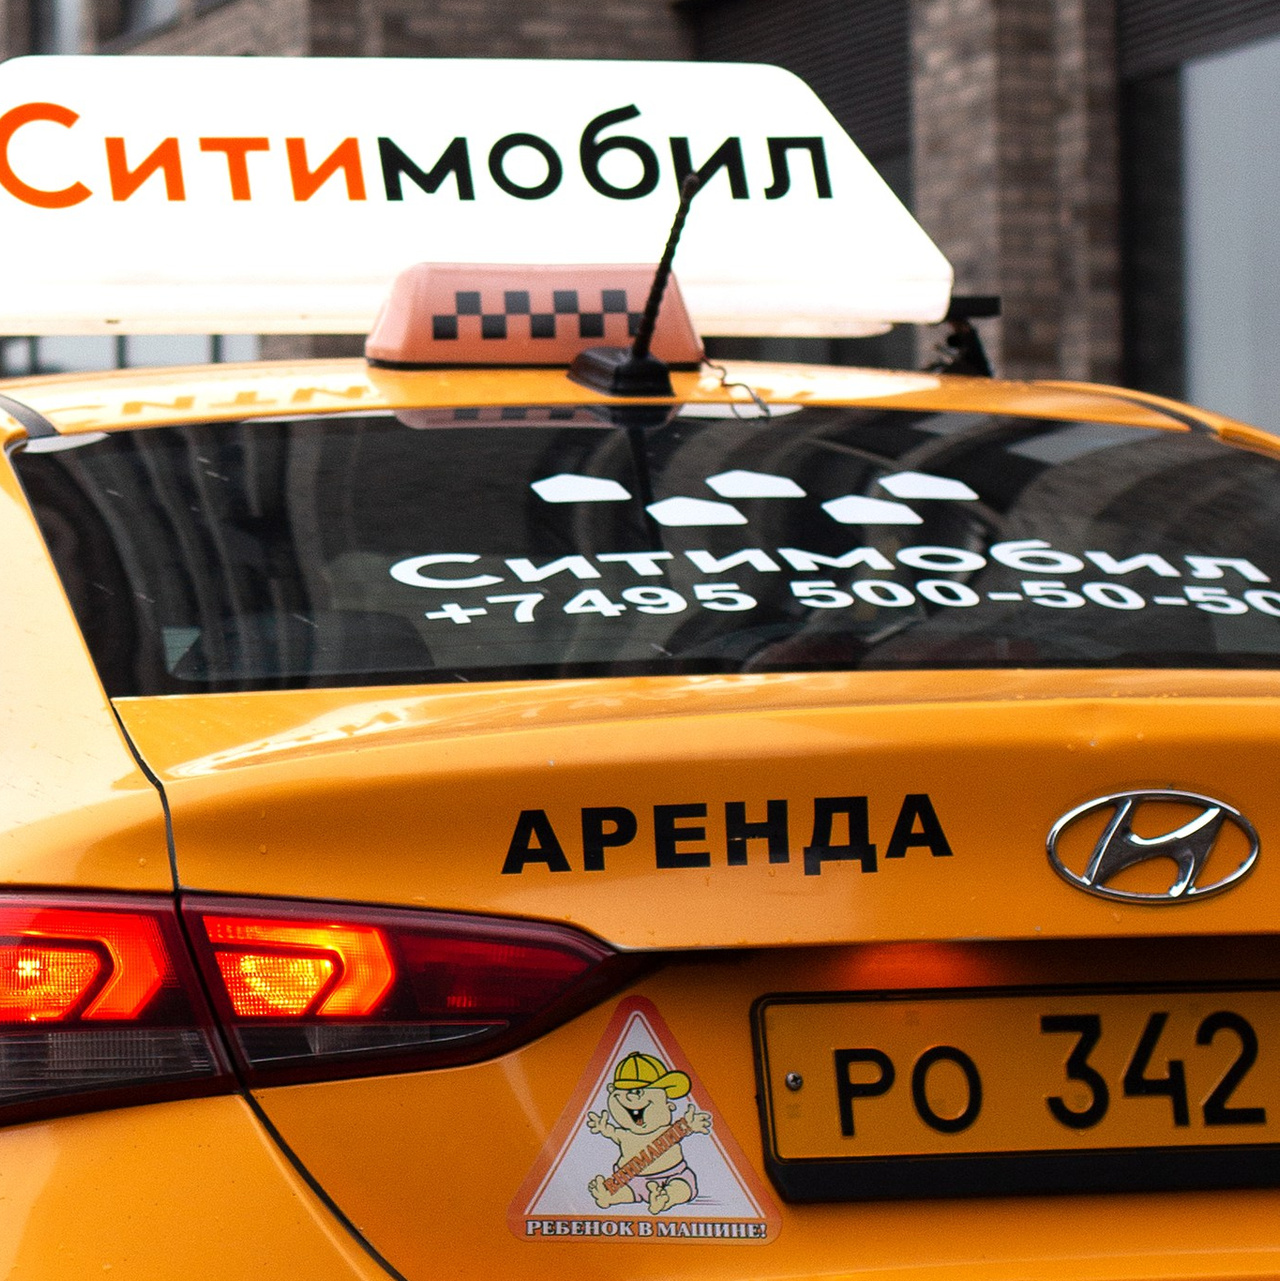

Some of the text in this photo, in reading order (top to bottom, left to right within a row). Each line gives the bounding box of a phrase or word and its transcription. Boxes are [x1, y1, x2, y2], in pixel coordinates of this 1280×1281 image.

[389, 538, 1271, 589] Ситимобил
[424, 582, 759, 625] +7495
[501, 793, 954, 876] АРЕНДА
[1039, 1008, 1268, 1131] 342
[525, 1220, 768, 1239] РЕБЕНОК В МАШИНЕ!
